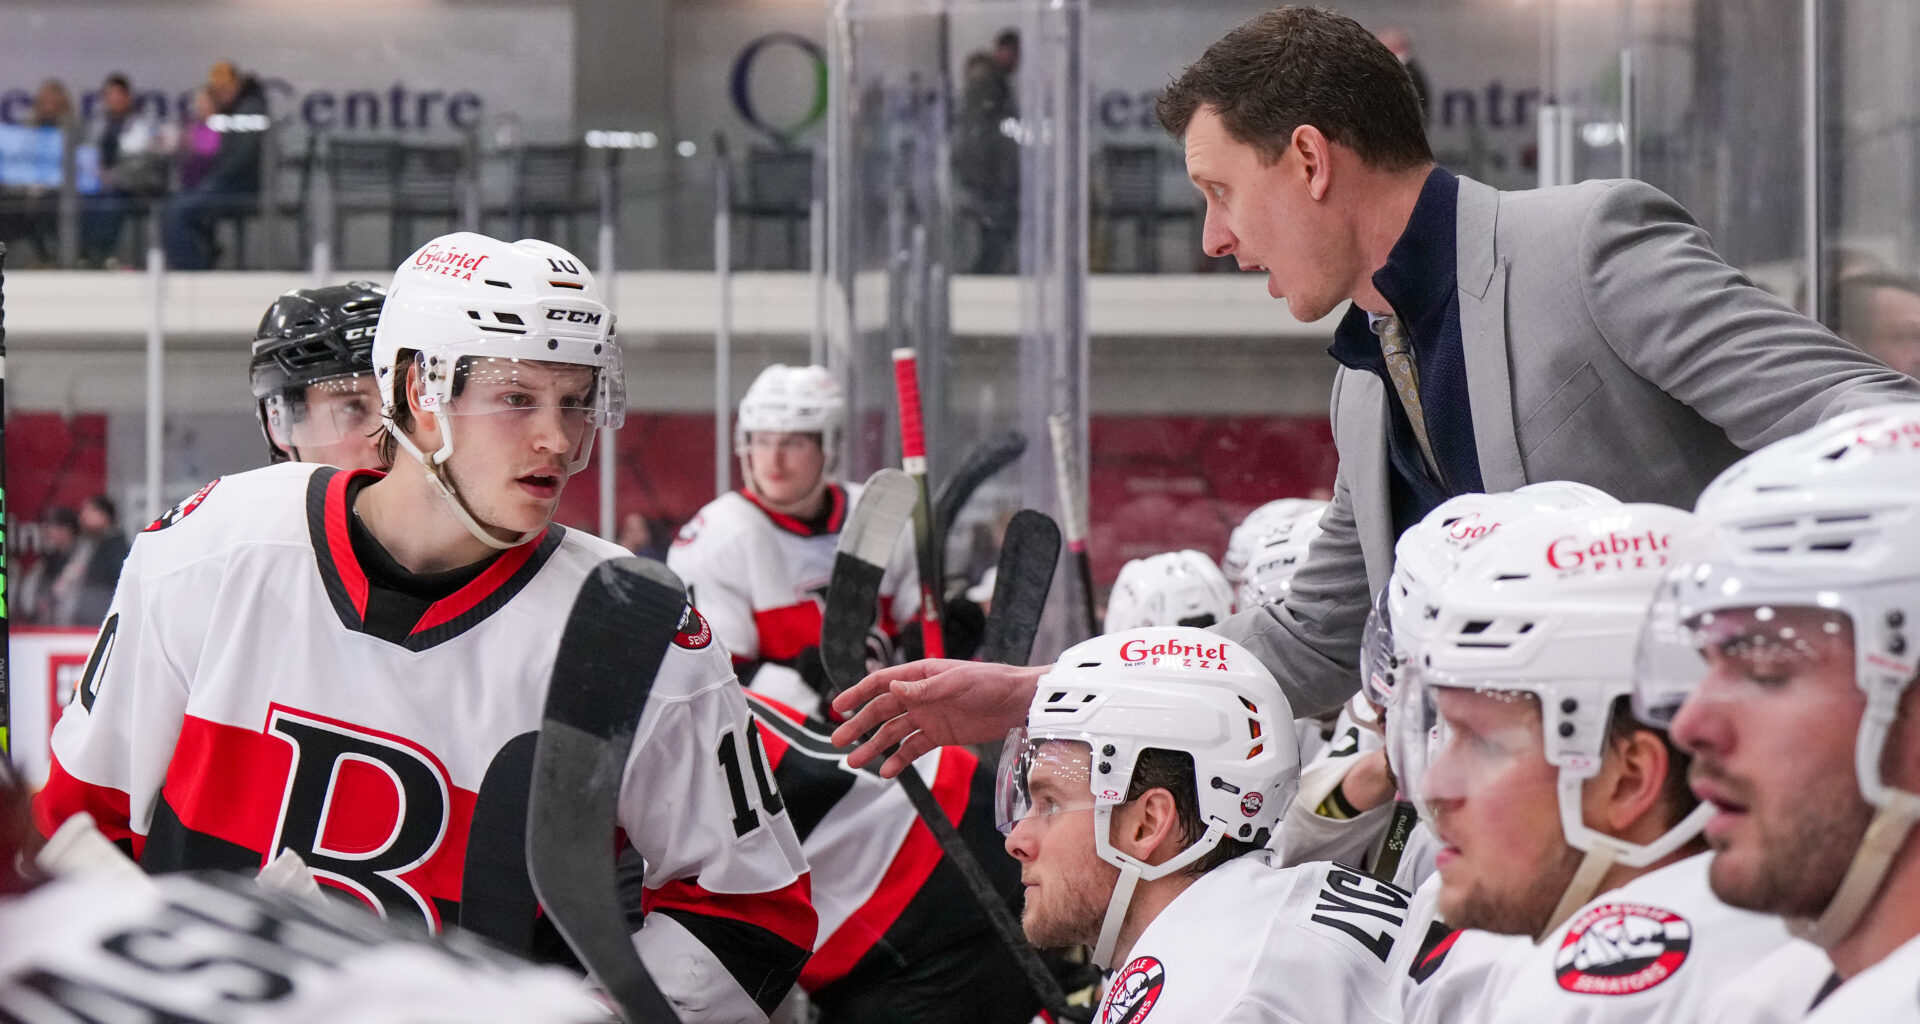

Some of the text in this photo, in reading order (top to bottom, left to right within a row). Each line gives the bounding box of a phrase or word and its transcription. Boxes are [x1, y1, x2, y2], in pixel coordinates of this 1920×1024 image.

[415, 244, 490, 271] Gabriel
[425, 264, 472, 282] PIZZA
[546, 308, 601, 325] CCM
[345, 326, 377, 341] CC
[1119, 639, 1230, 662] Gabriel
[1152, 657, 1229, 672] PZZA
[716, 714, 785, 832] 10
[1310, 860, 1413, 964] LYC
